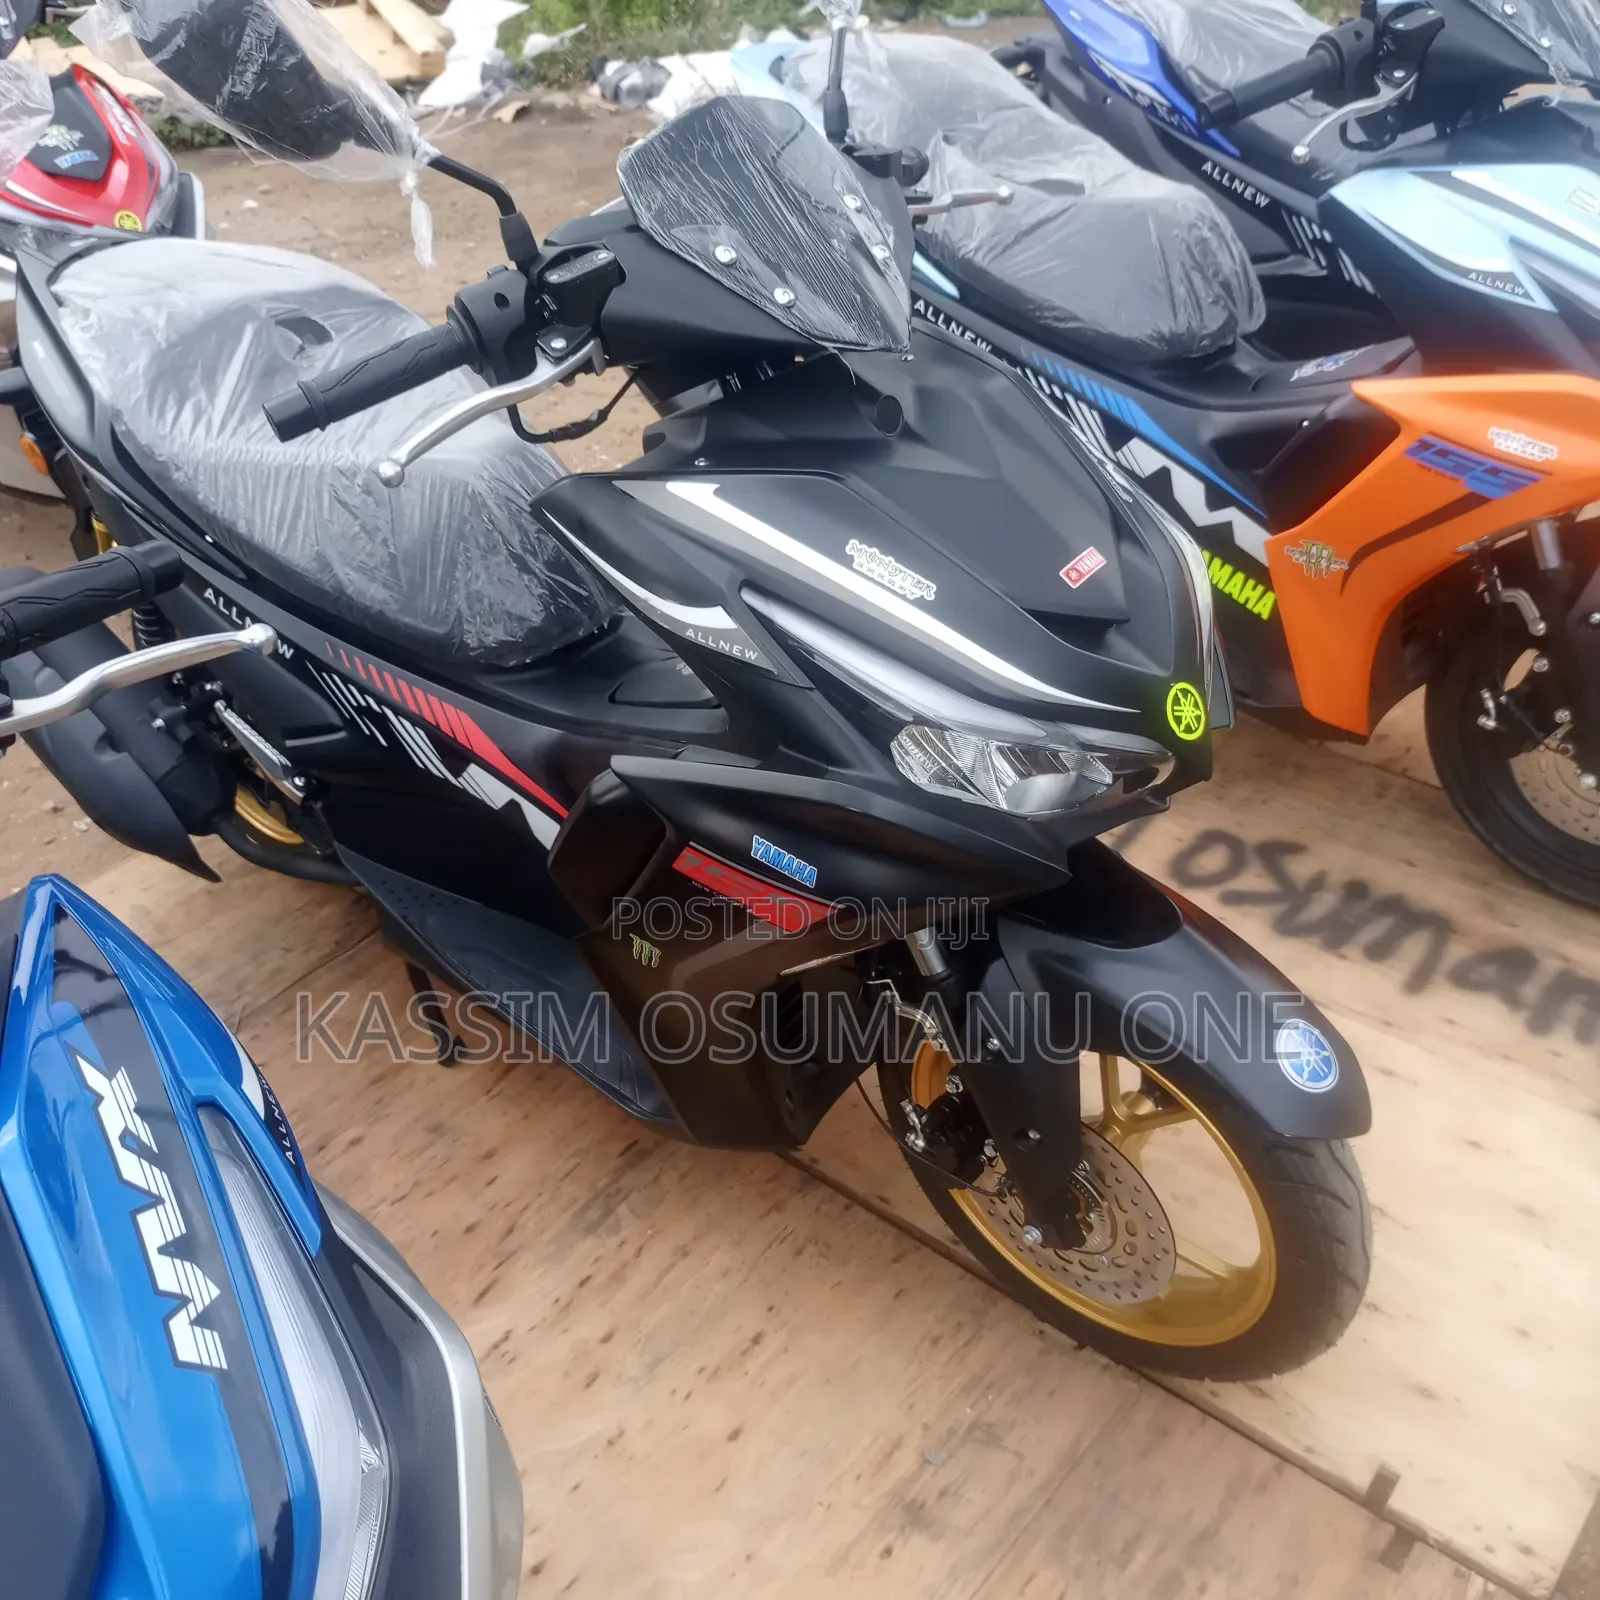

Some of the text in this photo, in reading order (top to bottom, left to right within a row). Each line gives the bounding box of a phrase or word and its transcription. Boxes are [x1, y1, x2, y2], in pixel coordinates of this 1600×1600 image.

[1201, 160, 1271, 208] ALLNEW
[1467, 271, 1525, 296] ALLNEW
[685, 628, 758, 661] ALLNEW
[751, 835, 818, 889] YAMAHA
